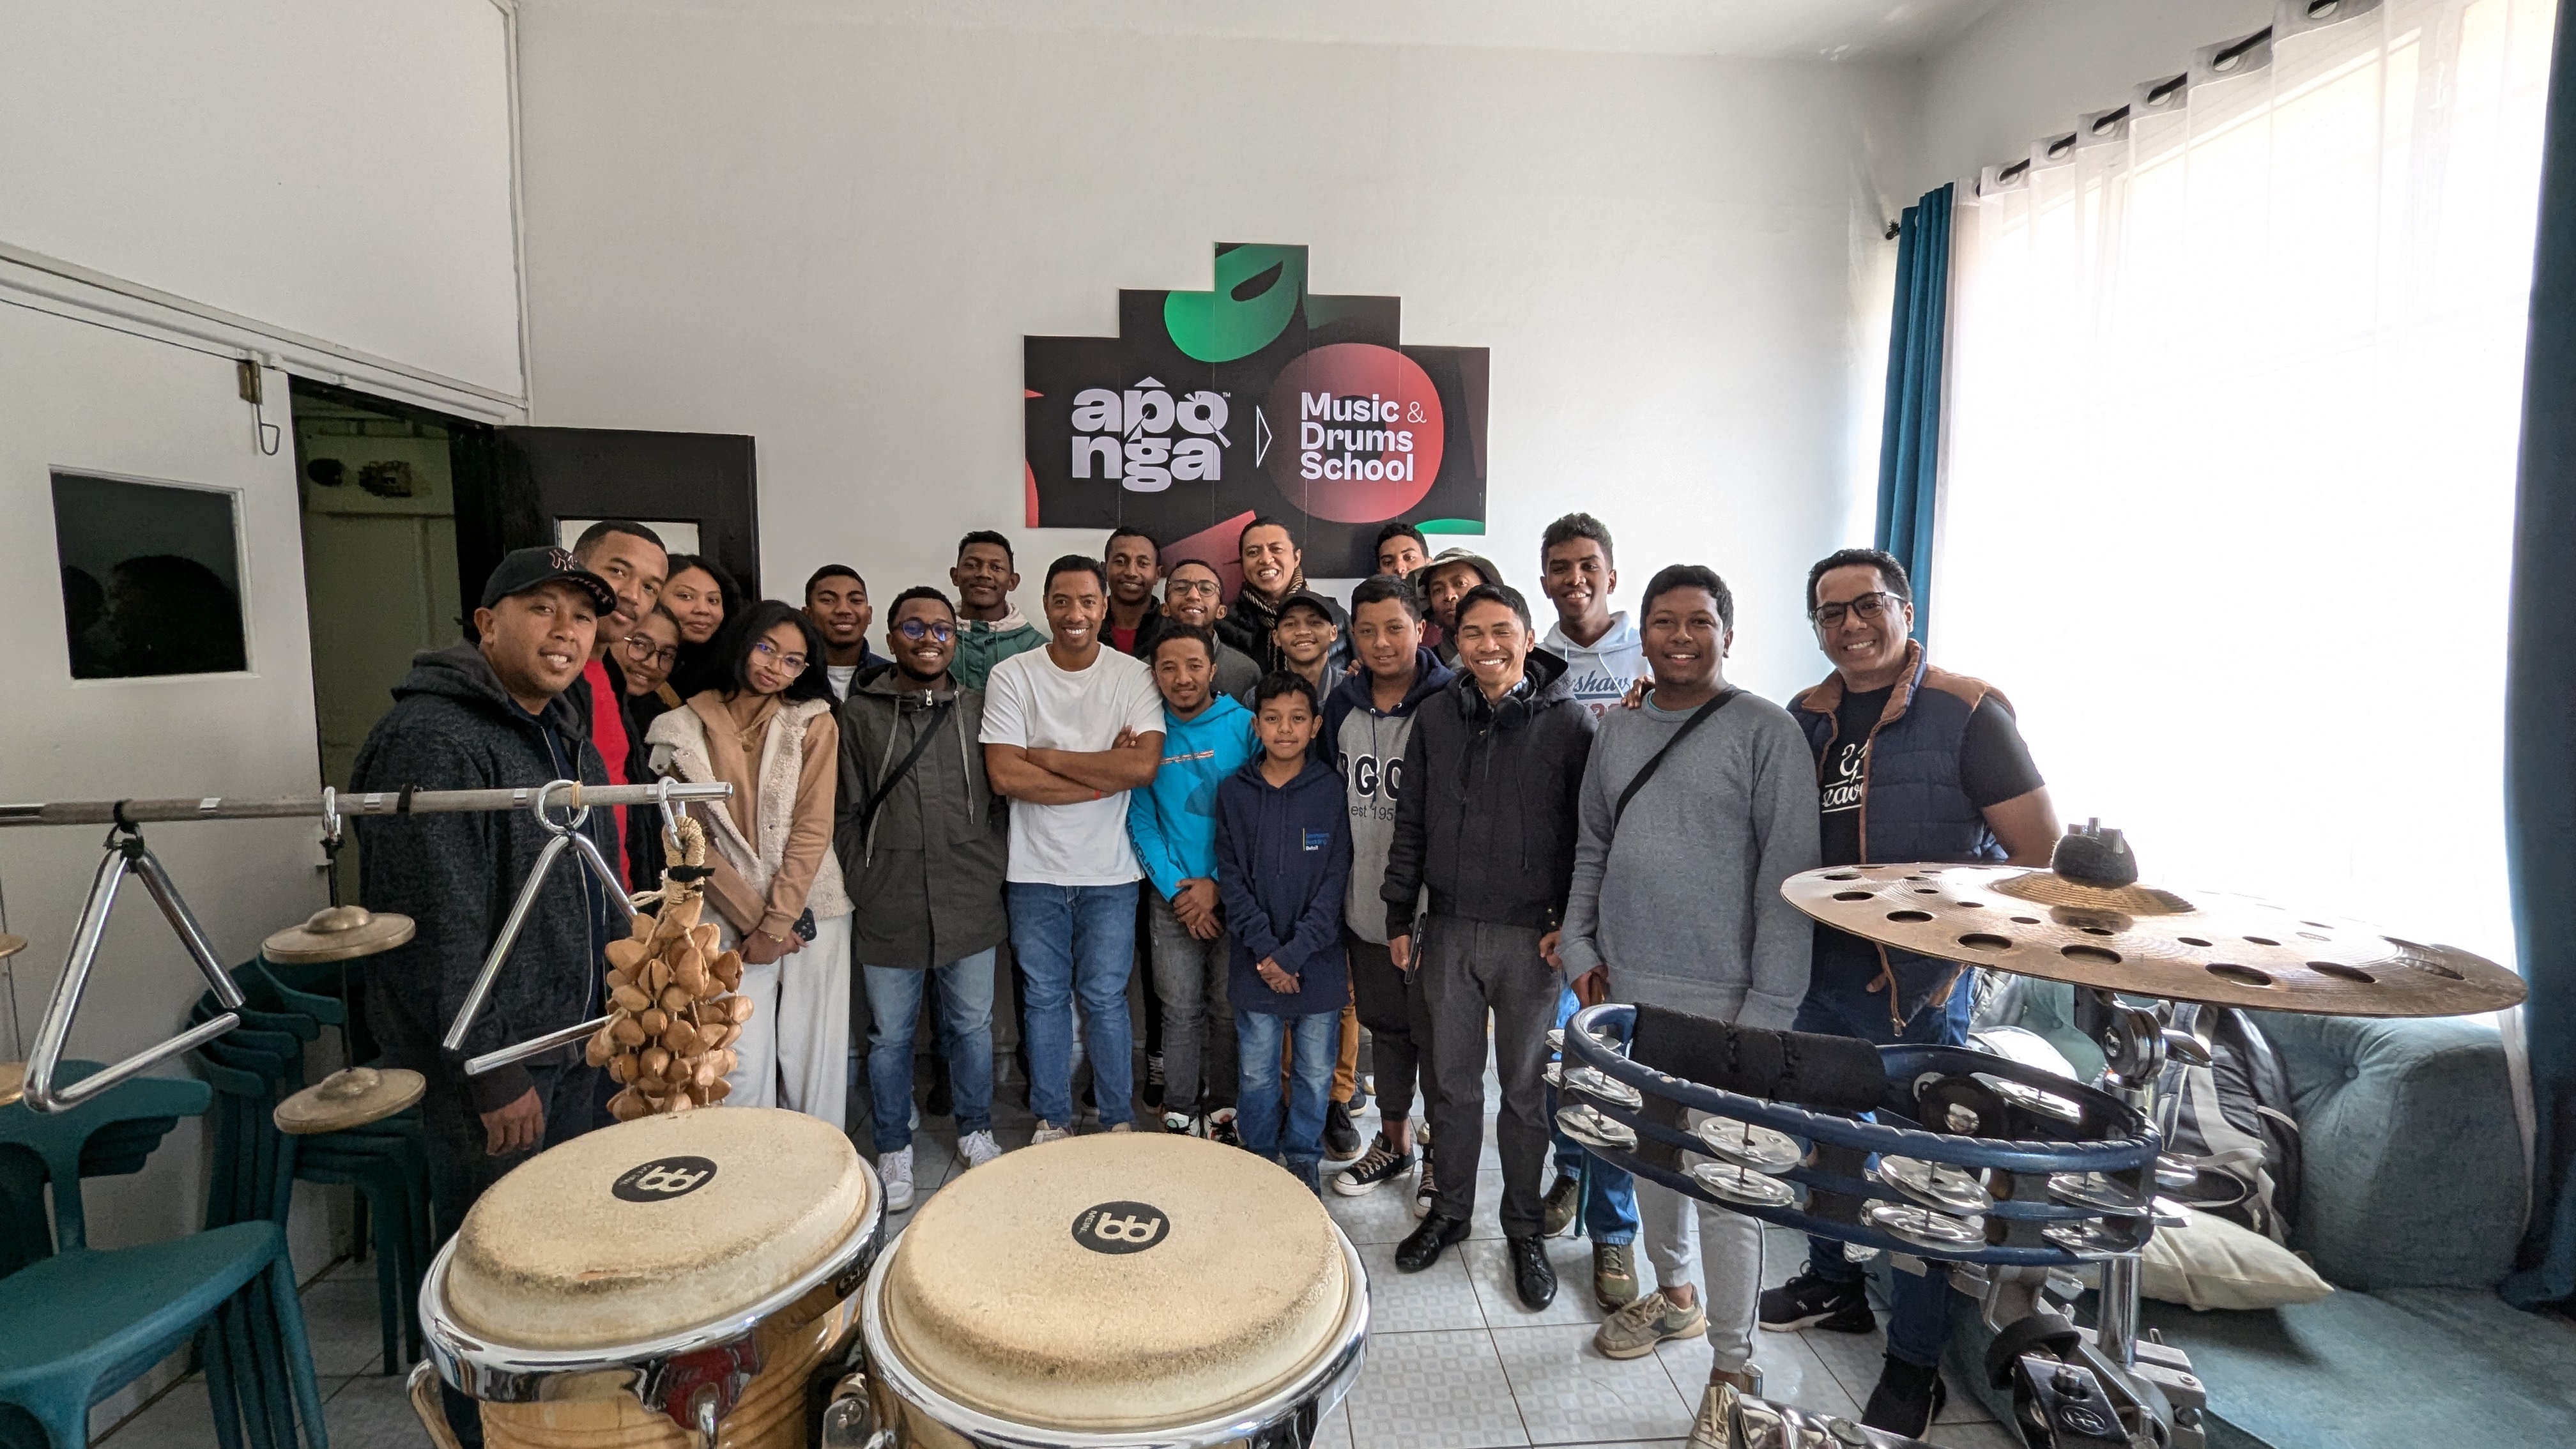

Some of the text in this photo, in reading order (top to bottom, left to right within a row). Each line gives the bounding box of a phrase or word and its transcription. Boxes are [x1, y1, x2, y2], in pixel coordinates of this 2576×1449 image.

[1301, 392, 1427, 424] Music &
[1301, 422, 1413, 452] Drums
[1072, 436, 1221, 492] nga
[1300, 451, 1414, 481] School
[1572, 670, 1631, 693] shaw
[1351, 805, 1367, 818] est
